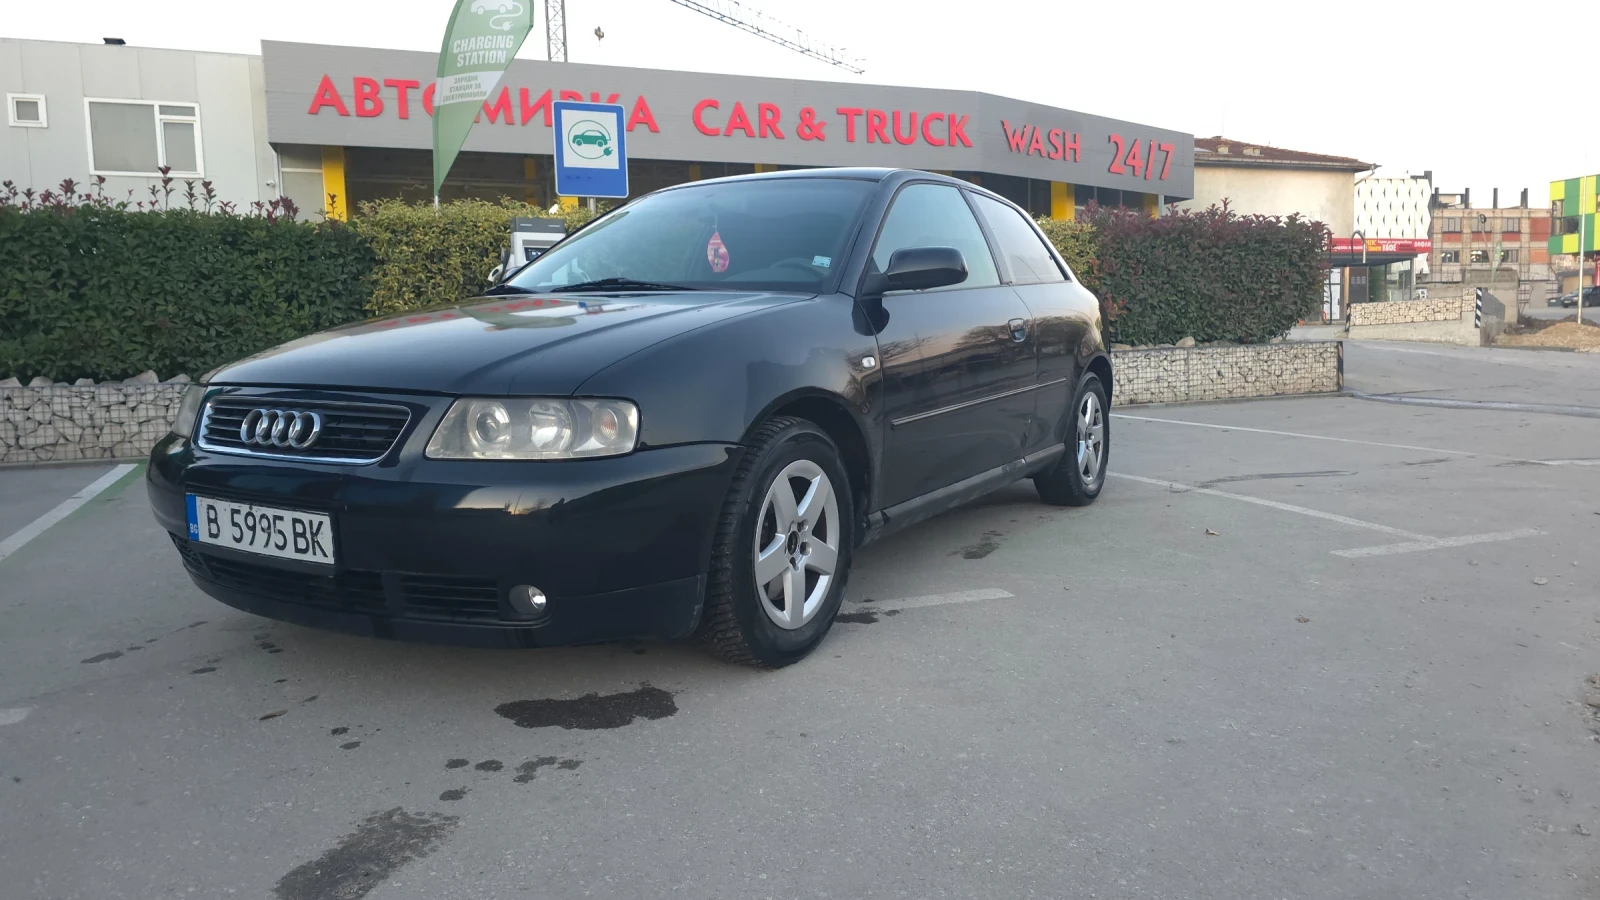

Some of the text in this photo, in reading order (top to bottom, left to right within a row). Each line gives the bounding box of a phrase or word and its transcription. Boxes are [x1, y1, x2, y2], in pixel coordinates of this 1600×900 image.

[453, 35, 514, 53] CHARGING
[457, 50, 506, 67] STATION
[307, 74, 660, 133] АВТМИА
[692, 98, 1175, 180] CAR & TRUCK WASH 24/7
